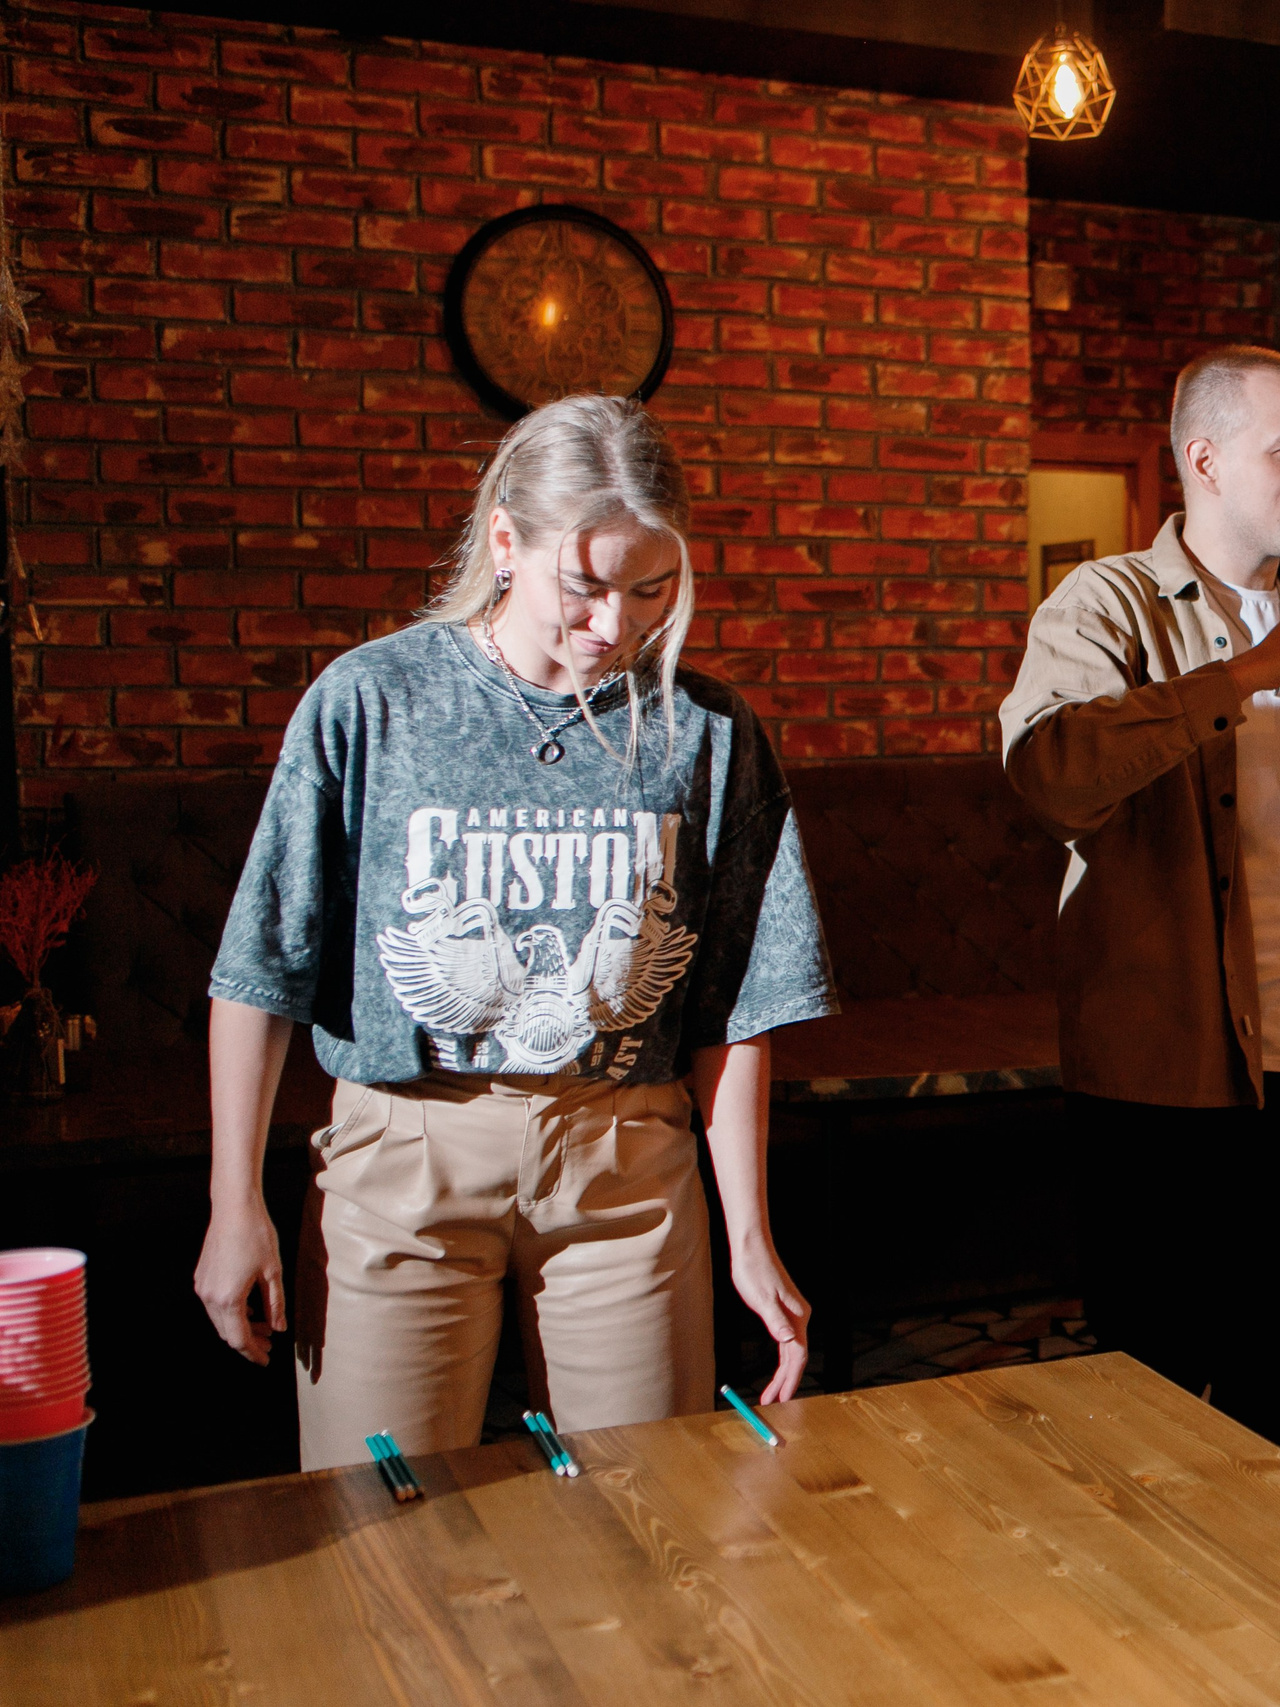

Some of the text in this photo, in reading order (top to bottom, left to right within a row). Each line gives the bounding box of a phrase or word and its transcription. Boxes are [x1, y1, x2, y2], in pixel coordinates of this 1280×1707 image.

[466, 808, 628, 827] AMERICAN
[405, 807, 682, 911] CUSTOM
[605, 1035, 644, 1081] AST
